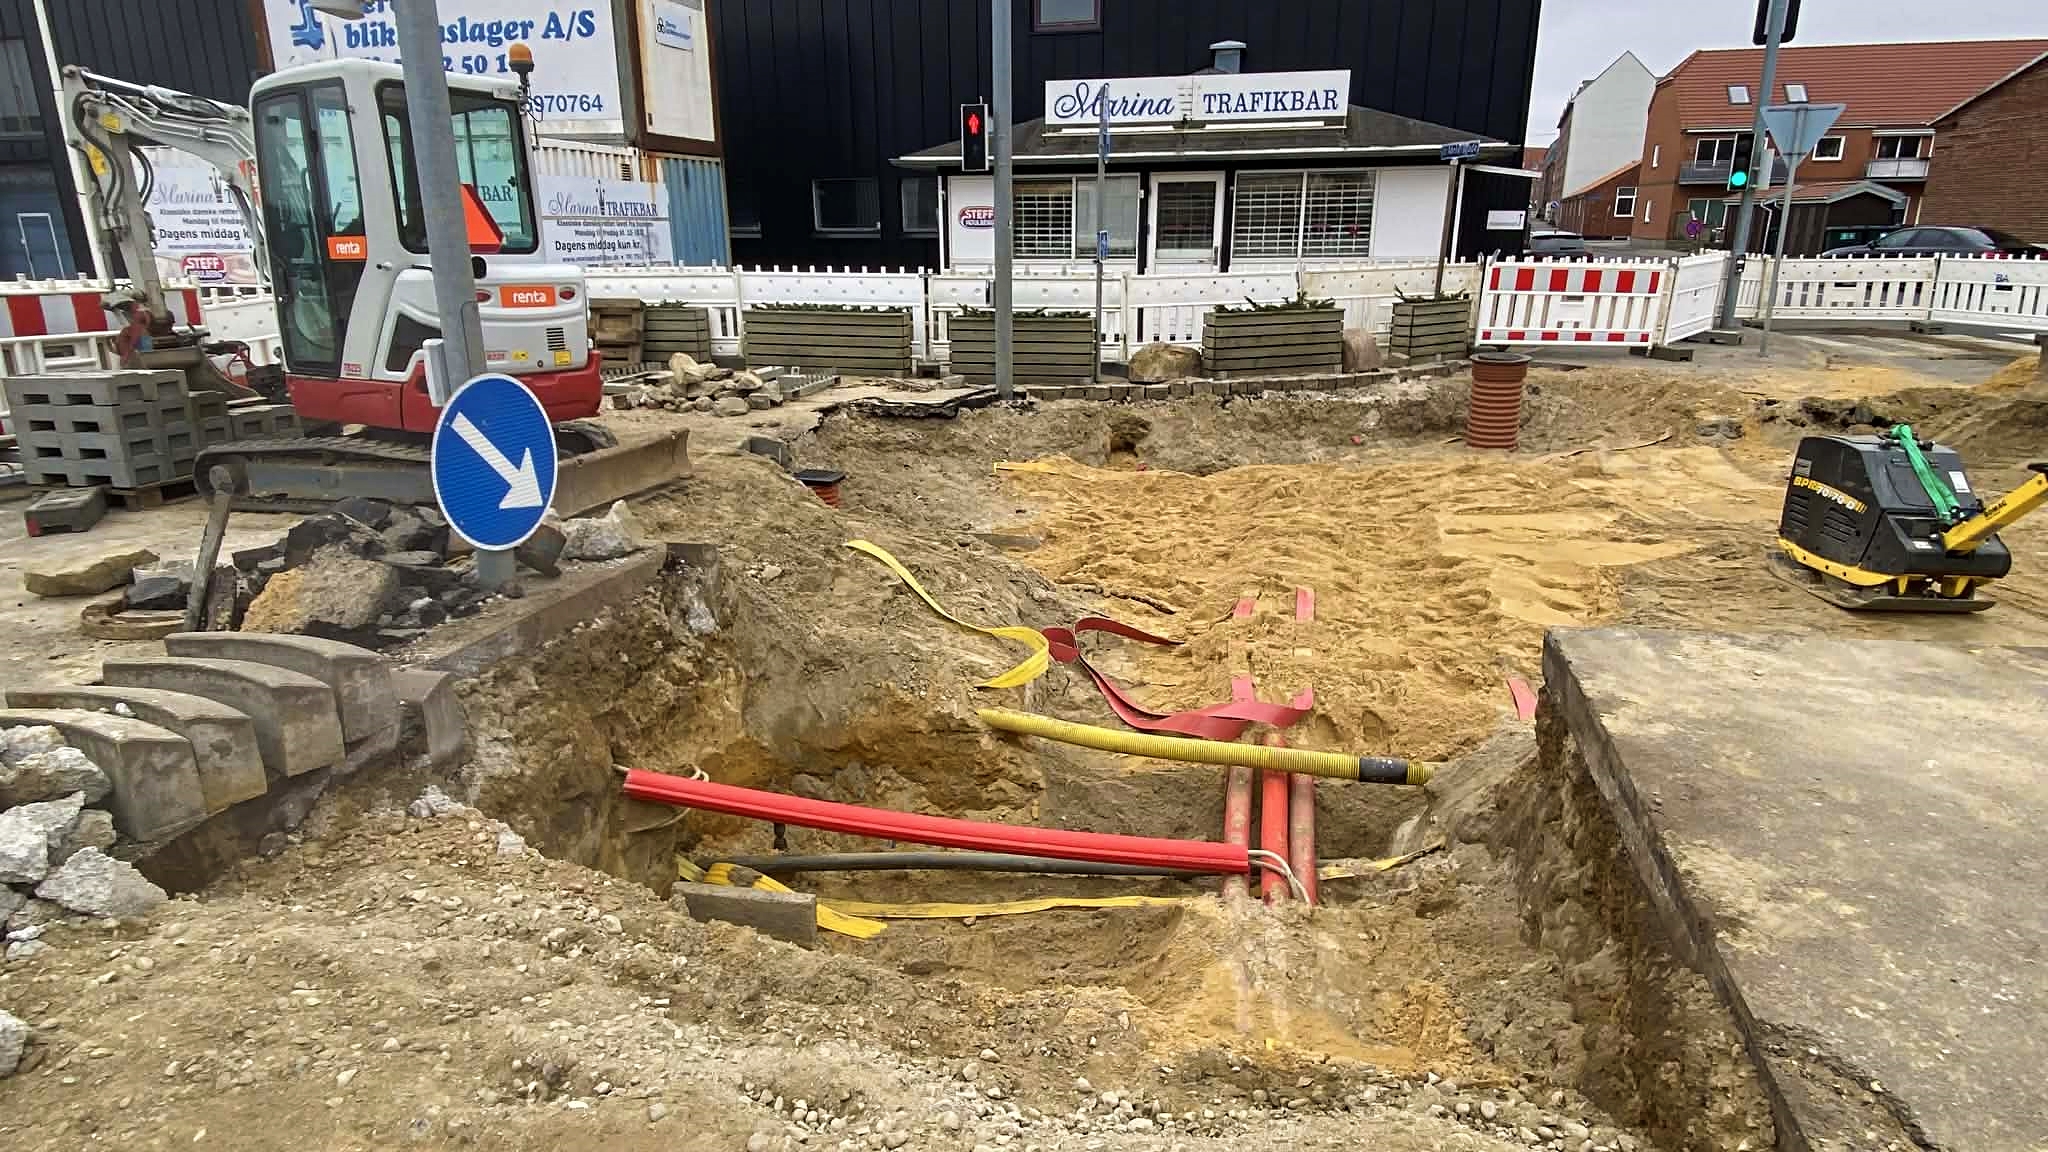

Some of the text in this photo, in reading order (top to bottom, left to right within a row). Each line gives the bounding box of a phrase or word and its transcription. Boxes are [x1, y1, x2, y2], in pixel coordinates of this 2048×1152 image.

[542, 10, 596, 41] A/S
[462, 54, 488, 74] 50
[1054, 82, 1339, 119] Marina TRAFIKBAR
[605, 201, 658, 217] TRAFIKBAR
[159, 228, 198, 241] Dagens
[200, 228, 241, 241] middag
[336, 242, 361, 254] renta
[555, 240, 586, 253] Dagens
[588, 239, 616, 251] middag
[617, 239, 631, 250] kun
[186, 257, 219, 270] STEFF
[513, 291, 547, 304] renta
